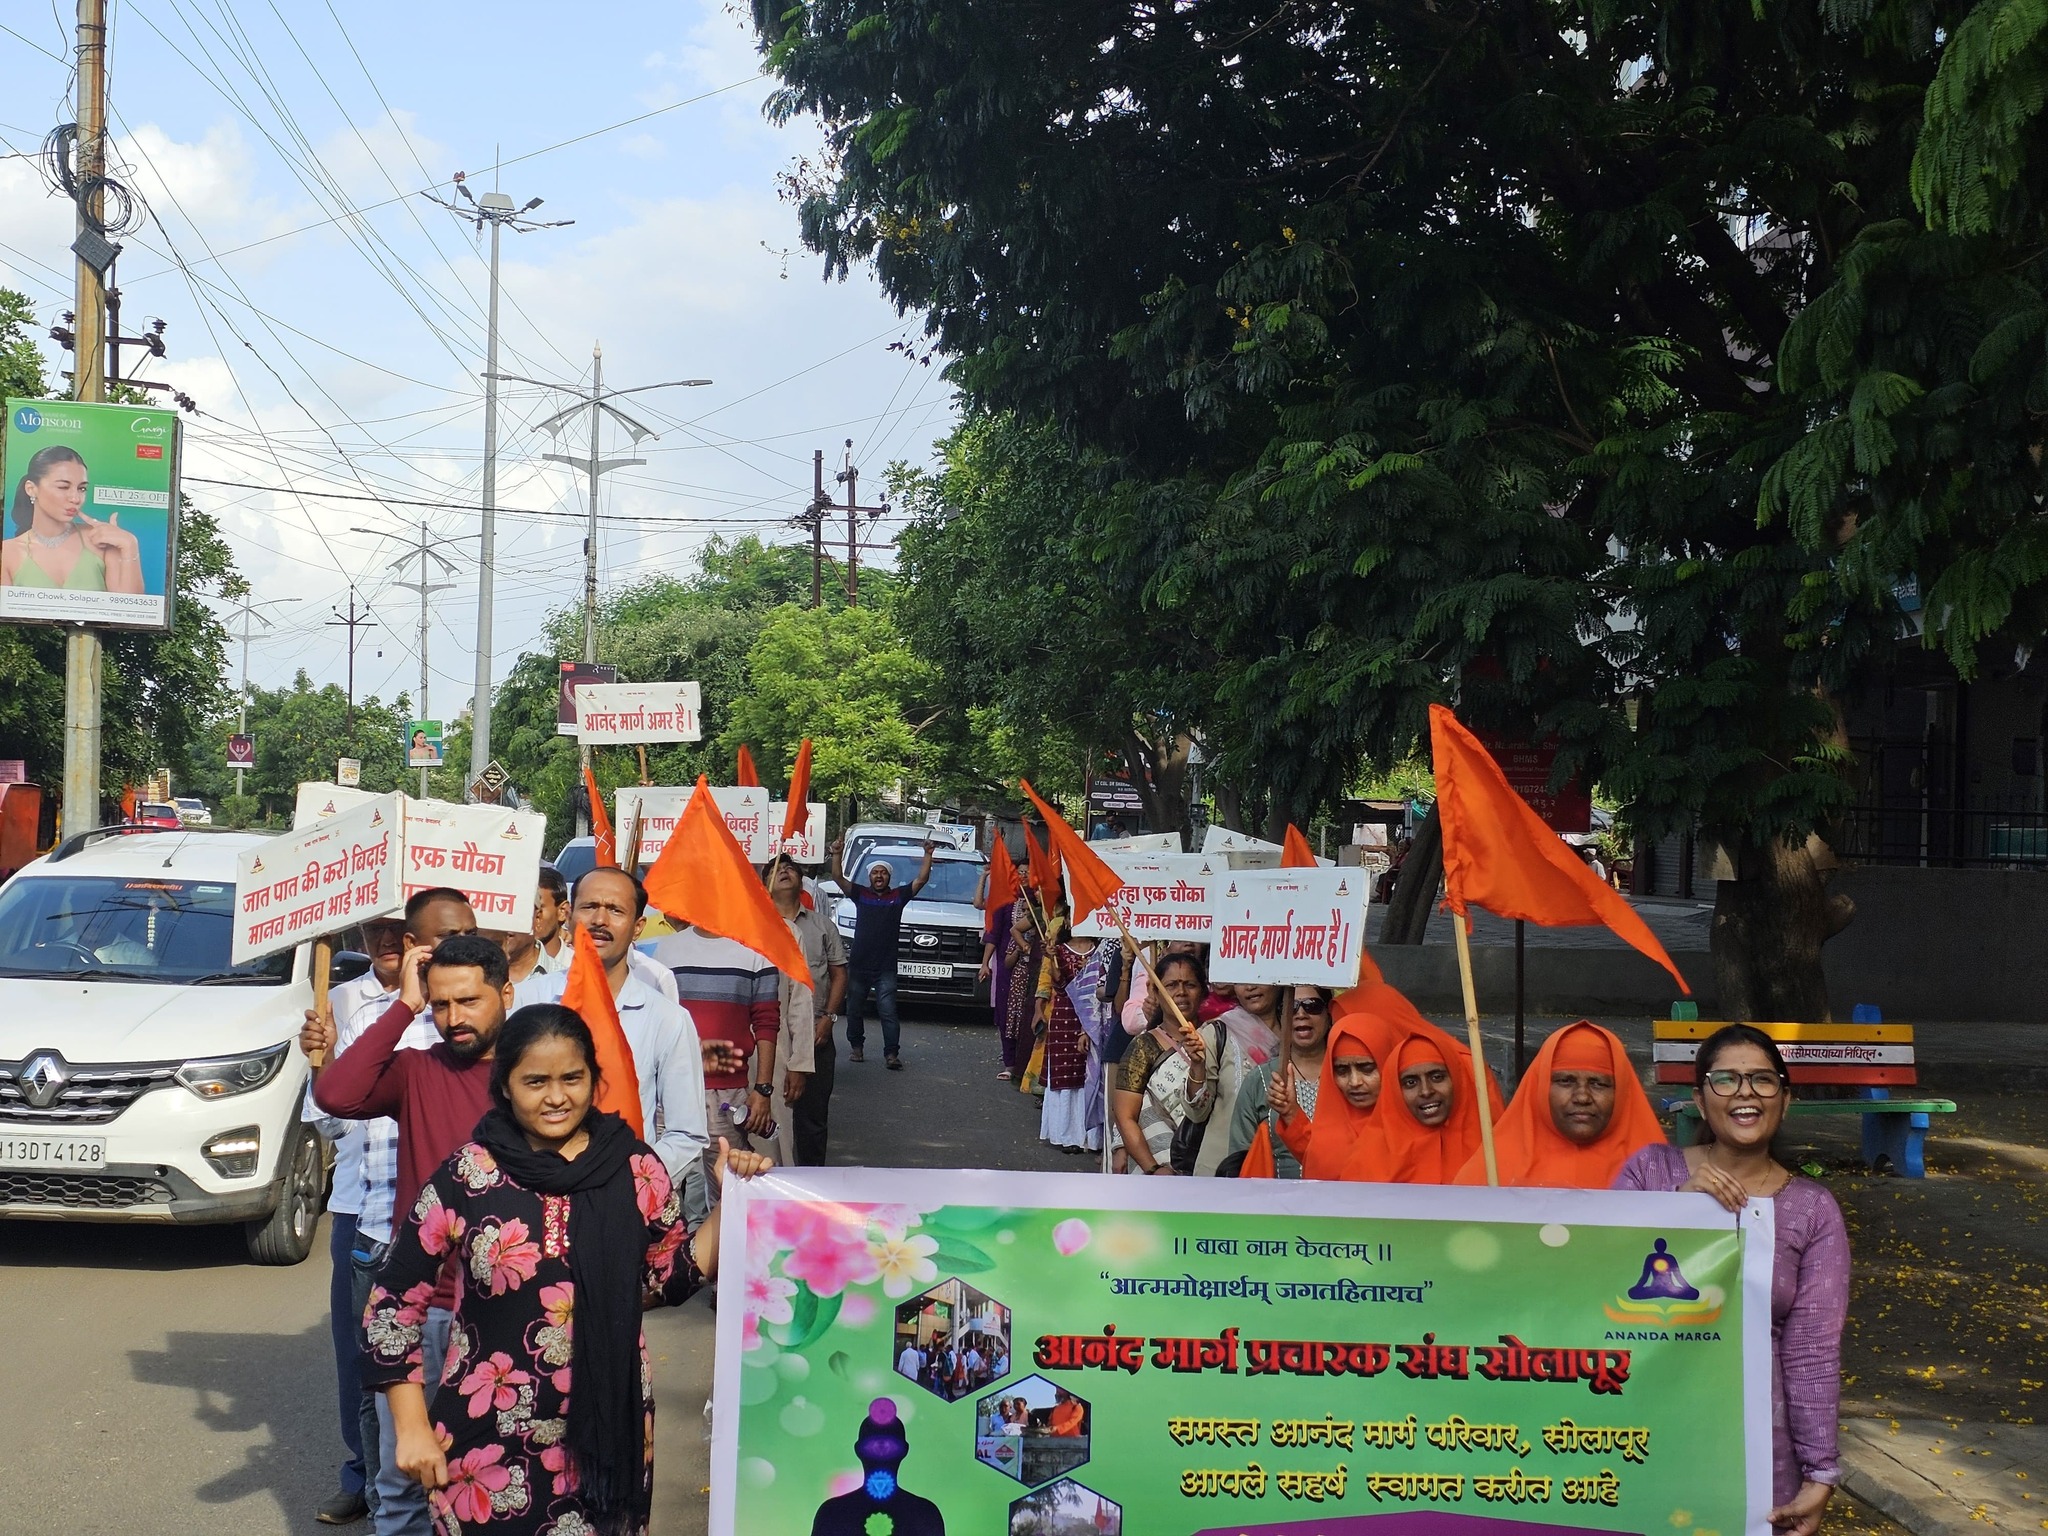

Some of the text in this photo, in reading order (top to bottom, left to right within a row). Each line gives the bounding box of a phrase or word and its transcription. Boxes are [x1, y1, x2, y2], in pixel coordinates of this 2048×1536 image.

[20, 412, 82, 429] Monsoon
[131, 417, 167, 437] Gargi
[98, 488, 125, 499] FLAT
[128, 490, 147, 500] 25%
[148, 492, 169, 502] OFF
[7, 590, 35, 600] Duffrin
[37, 591, 67, 601] Chowk,
[69, 593, 100, 604] Solapur
[109, 596, 158, 607] 9890543633
[585, 705, 616, 734] आनंद
[619, 704, 645, 731] मार्ग
[647, 711, 673, 731] अमर
[1513, 755, 1539, 764] BHMS
[652, 817, 675, 831] पात
[724, 811, 759, 833] बिदाई
[410, 840, 506, 876] एक चौका
[243, 830, 390, 913] जात पात की करो बिदाई
[1143, 886, 1166, 905] एक
[1169, 879, 1205, 903] चौका
[248, 915, 285, 945] मानव
[288, 900, 326, 931] मानव
[328, 880, 354, 916] भाई
[355, 869, 380, 906] भाई
[1134, 913, 1172, 930] मानव
[1174, 914, 1213, 931] समाज
[1219, 909, 1260, 965] आनंद
[1260, 908, 1294, 959] मार्ग
[1292, 925, 1327, 961] अमर
[902, 964, 951, 976] MH13ES9197
[1196, 1238, 1239, 1256] बाबा
[1246, 1239, 1288, 1257] नाम
[1295, 1236, 1373, 1266] केवलम्
[1604, 1331, 1721, 1341] ANANDA MARGA
[1033, 1323, 1632, 1396] आनंद मार्ग प्रचारक संघ सोलापूर
[1168, 1411, 1650, 1464] समस्त आनंद मार्ग परिवार, सोलापूर
[1180, 1460, 1620, 1507] आपले सहर्ष स्वागत करीत आहे
